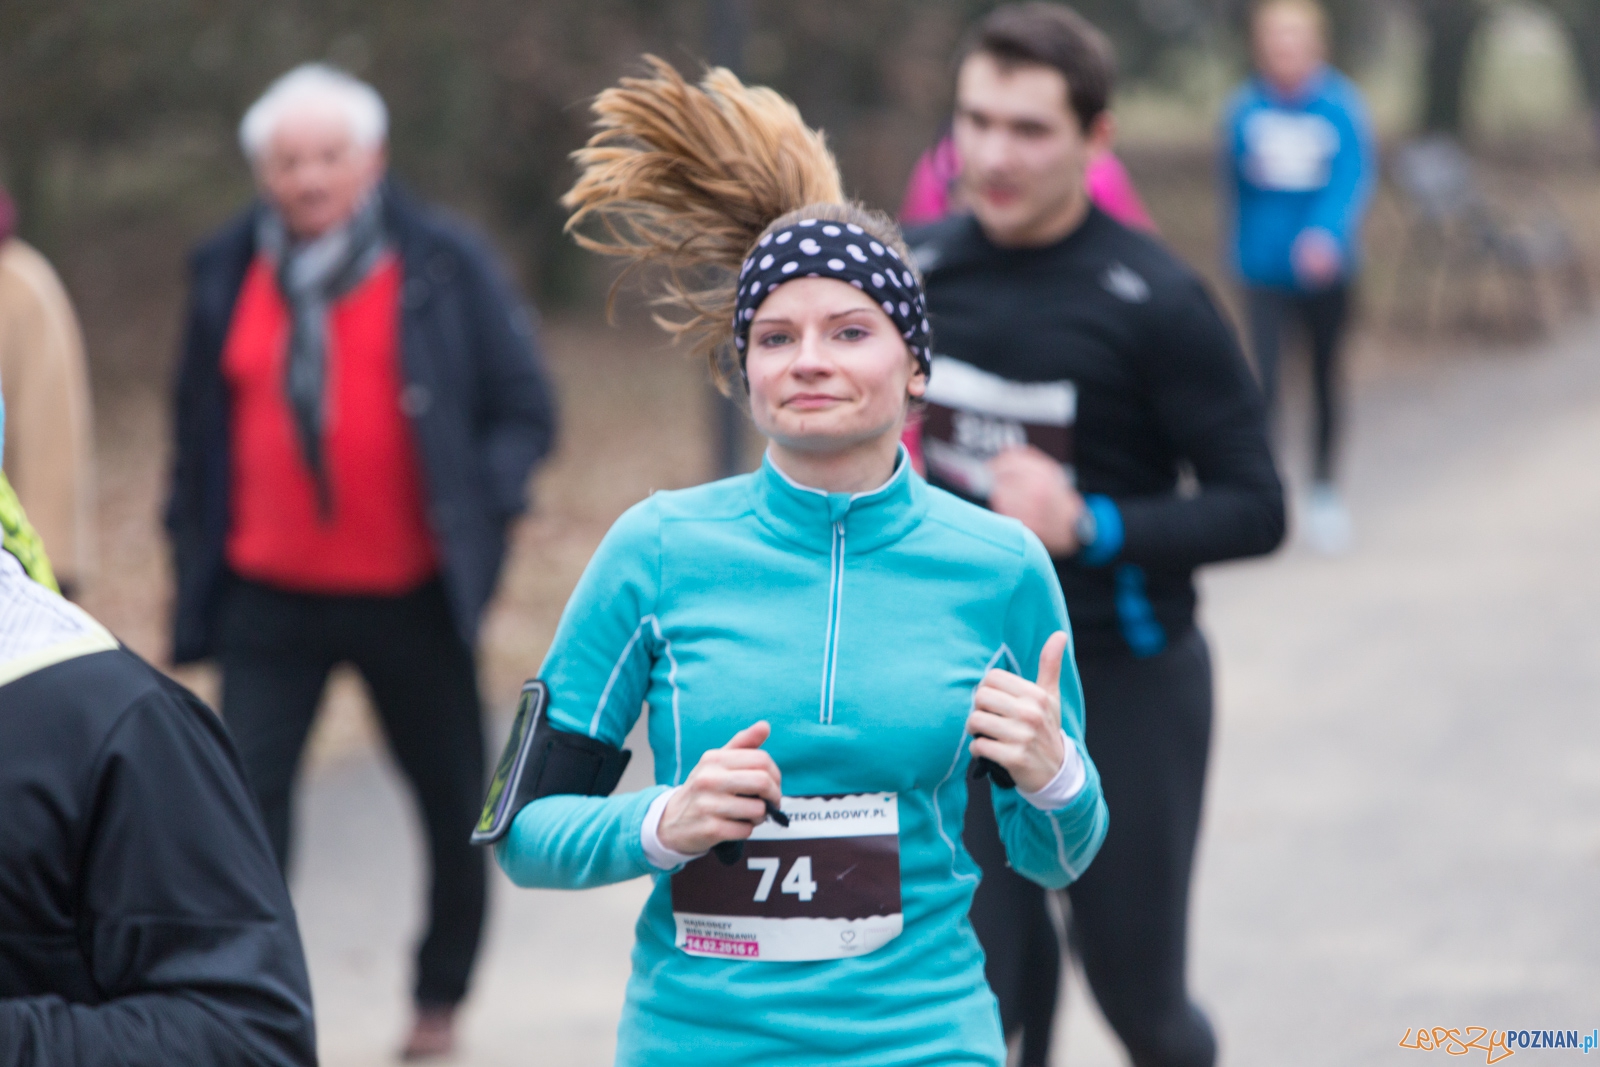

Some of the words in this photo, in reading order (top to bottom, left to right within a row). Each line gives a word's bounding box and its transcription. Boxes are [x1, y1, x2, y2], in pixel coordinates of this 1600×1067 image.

[780, 808, 887, 822] ZEKOLADOWY.PL
[747, 856, 817, 902] 74
[714, 931, 757, 940] POZNANIU
[687, 938, 746, 954] 14.02.2016
